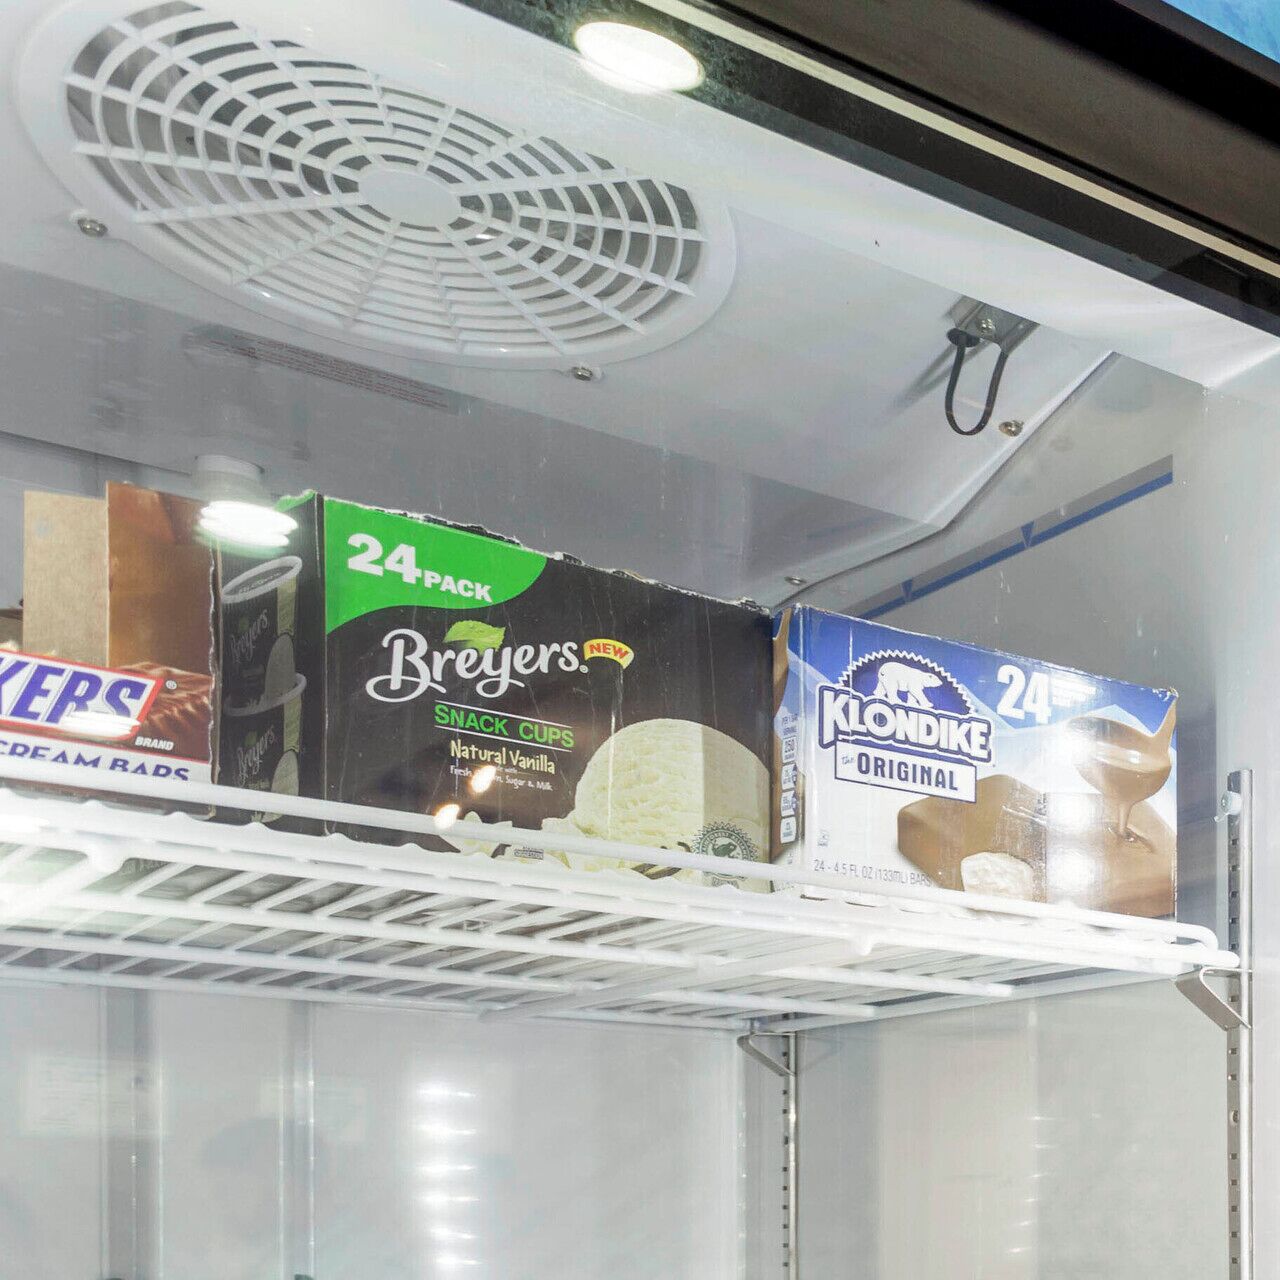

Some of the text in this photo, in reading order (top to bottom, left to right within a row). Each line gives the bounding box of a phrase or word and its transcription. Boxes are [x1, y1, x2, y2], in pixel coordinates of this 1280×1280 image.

[347, 533, 493, 603] 24 PACK
[366, 628, 580, 703] Breyers
[588, 643, 630, 660] NEW
[996, 664, 1052, 724] 24
[135, 735, 175, 751] BRAND
[434, 703, 576, 748] SNACK CUPS
[821, 690, 992, 758] KLONDIKE
[450, 738, 556, 775] Natural Vanilla
[857, 751, 958, 792] ORIGINAL
